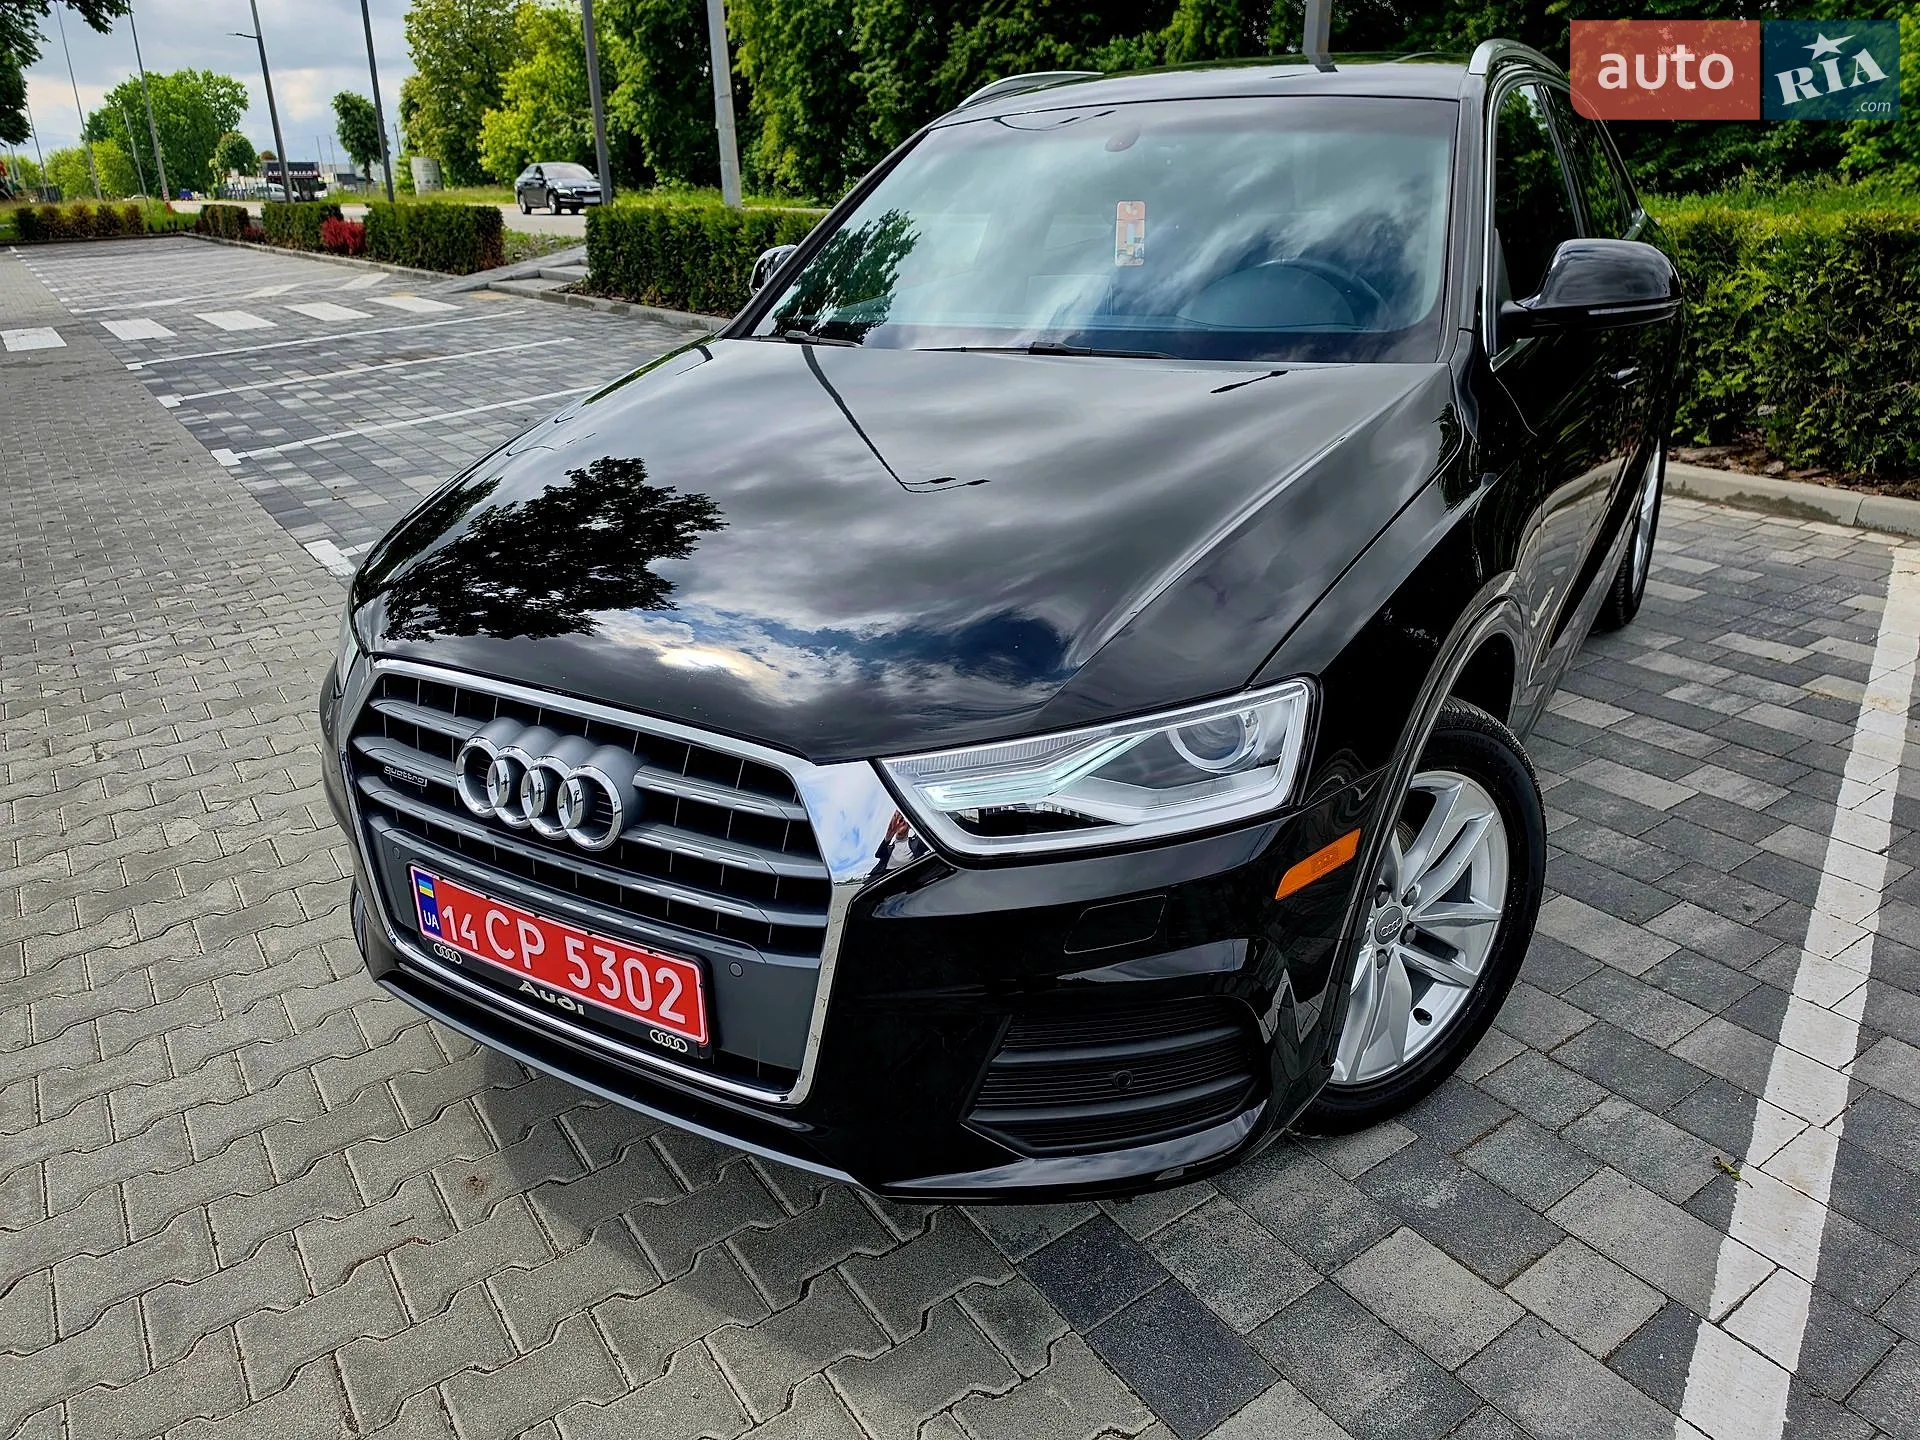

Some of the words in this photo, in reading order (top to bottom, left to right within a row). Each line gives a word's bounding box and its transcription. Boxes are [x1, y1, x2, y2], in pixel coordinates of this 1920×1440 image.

[384, 765, 427, 787] quattro
[423, 909, 440, 930] UA
[441, 905, 479, 951] 14
[564, 935, 686, 1025] 5302
[518, 980, 585, 1016] Audi
